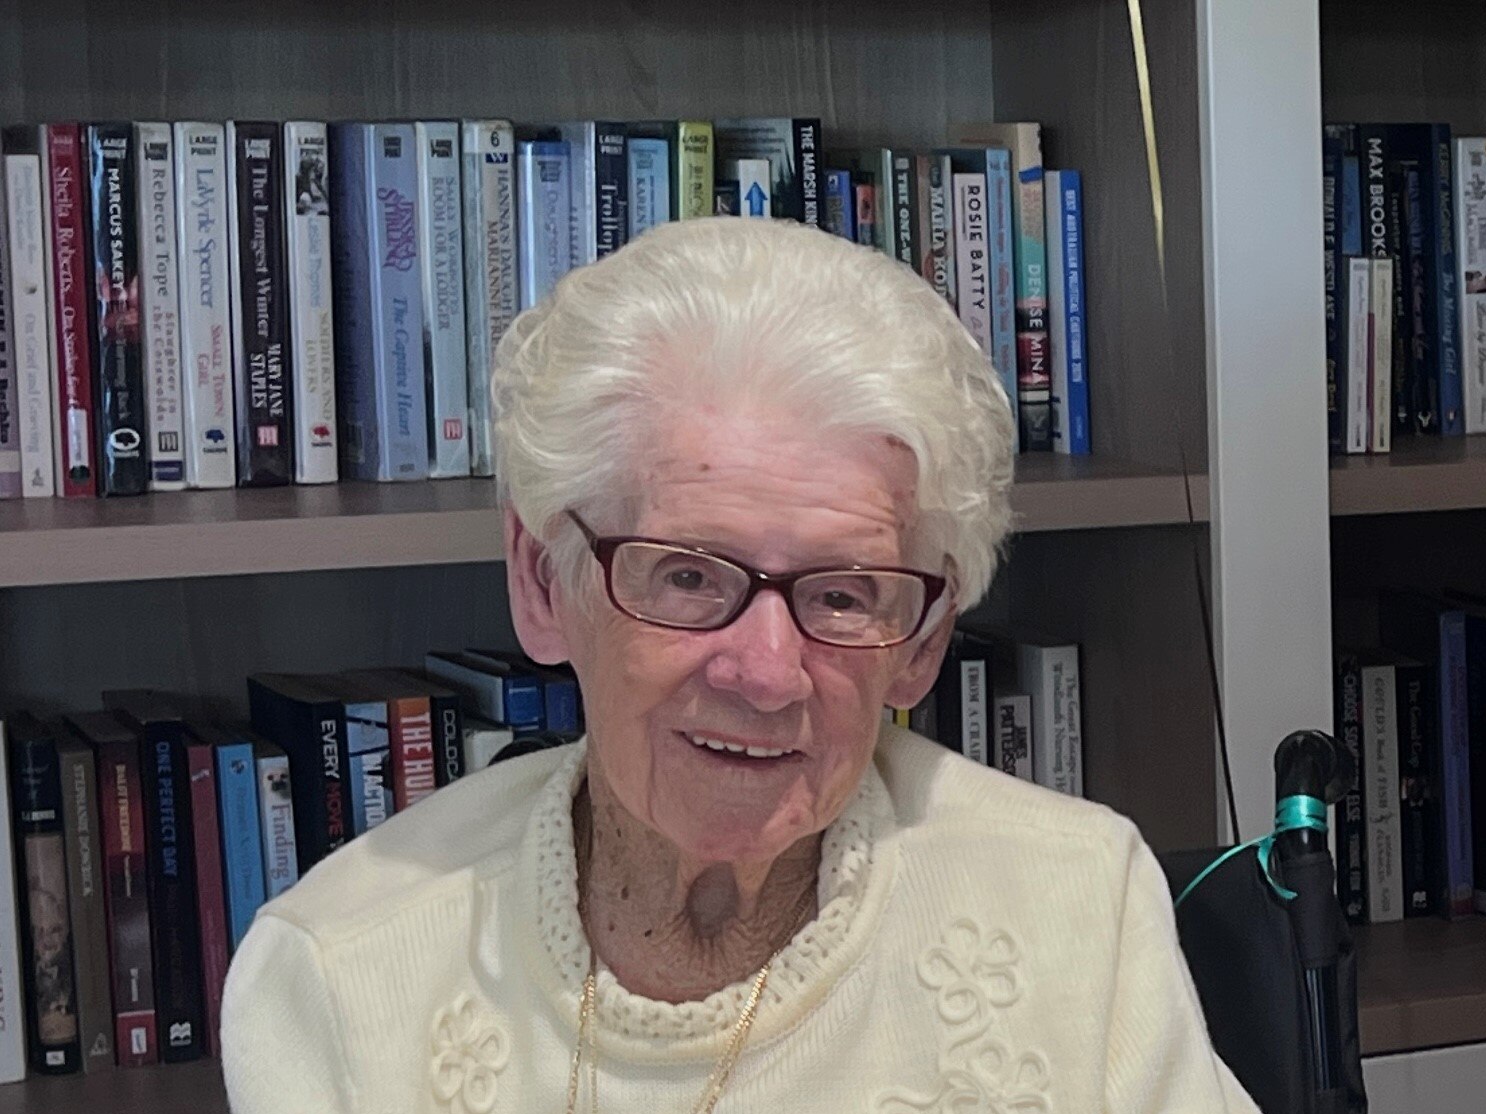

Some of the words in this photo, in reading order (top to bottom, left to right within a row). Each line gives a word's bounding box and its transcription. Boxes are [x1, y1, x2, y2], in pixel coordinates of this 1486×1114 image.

[490, 130, 502, 148] 6
[801, 125, 815, 151] THE
[1368, 137, 1384, 179] MAX
[56, 166, 74, 217] Sheila
[107, 167, 122, 236] MARCUS
[251, 163, 269, 197] The
[802, 153, 817, 199] MARSH
[897, 172, 910, 205] THE
[1064, 189, 1076, 211] BEST
[152, 167, 168, 244] Rebecca
[497, 169, 511, 244] HANNA'S
[967, 184, 983, 242] ROSIE
[1370, 184, 1388, 258] BROOKS
[249, 204, 270, 273] Longest
[899, 207, 912, 264] ONE-W
[111, 238, 125, 291] SAKEY
[154, 252, 171, 297] Tope
[196, 237, 215, 308] Spencer
[487, 220, 502, 309] MARIANNE
[969, 249, 985, 310] BATTY
[256, 276, 273, 338] Winter
[392, 296, 409, 326] The
[1028, 263, 1043, 328] DENISE
[250, 353, 267, 409] STAPLES
[267, 343, 282, 380] MARY
[1031, 335, 1045, 383] MINA
[269, 383, 284, 418] JANE
[398, 393, 414, 437] Heart
[968, 666, 980, 703] FROM
[155, 740, 172, 774] ONE
[320, 719, 340, 780] EVERY
[400, 711, 433, 756] THE
[158, 777, 176, 843] PERFECT
[324, 781, 344, 836] MOVE
[1346, 794, 1362, 823] ELSE
[162, 845, 178, 878] DAY
[270, 801, 293, 879] Finding
